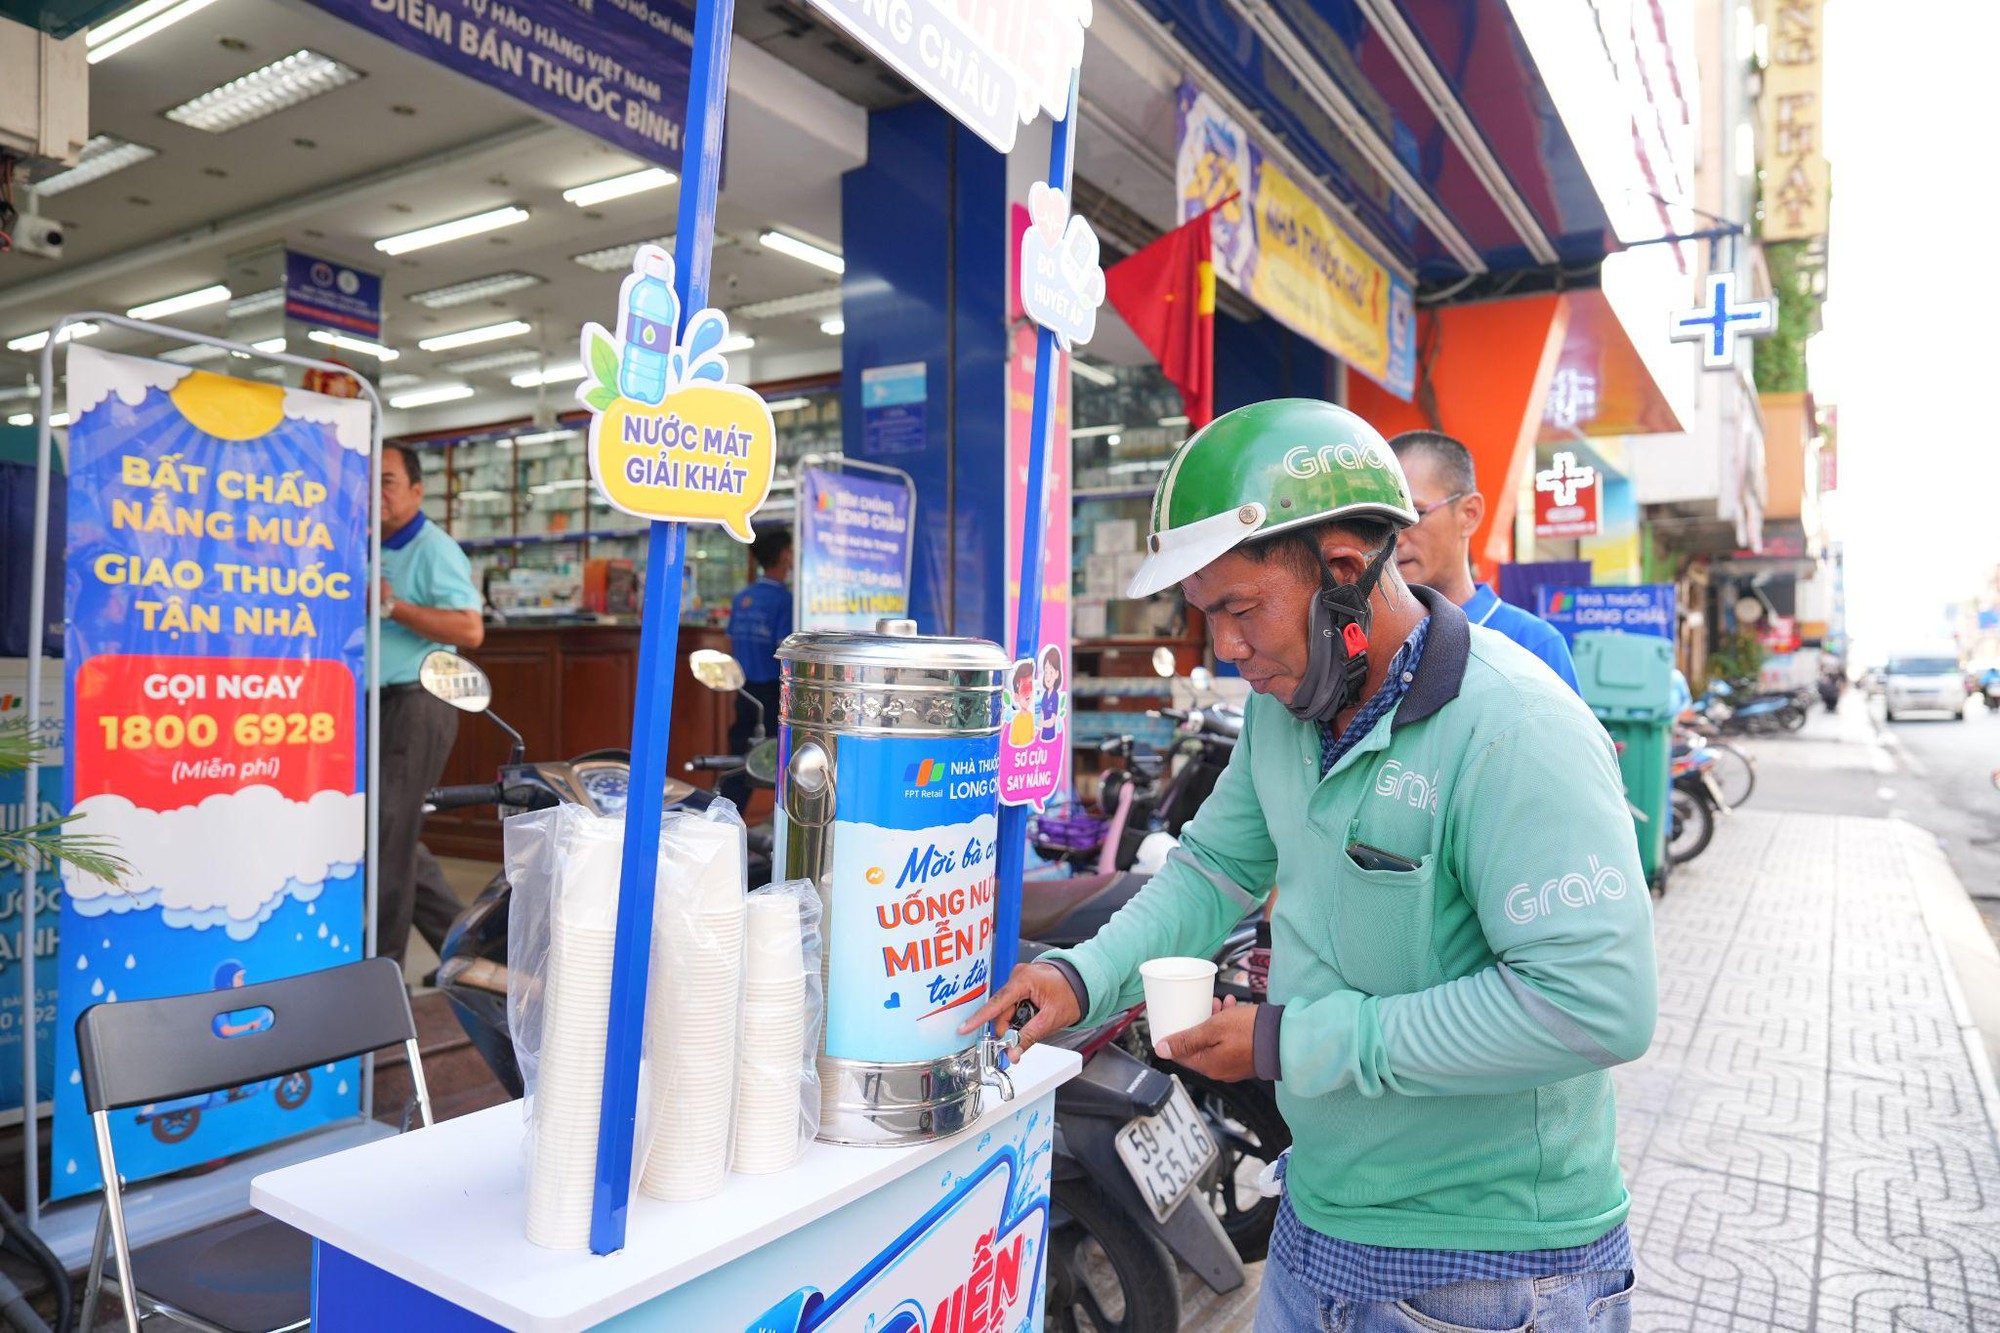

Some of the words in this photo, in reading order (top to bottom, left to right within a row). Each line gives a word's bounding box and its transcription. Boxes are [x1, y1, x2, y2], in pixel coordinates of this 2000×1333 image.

[459, 20, 523, 77] BÁN
[527, 51, 620, 122] THUỐC
[625, 98, 679, 151] BÌNH
[586, 49, 623, 82] VIỆT
[624, 69, 661, 103] NAM
[919, 23, 1000, 117] CHÂU
[624, 414, 697, 451] NƯỚC
[703, 424, 752, 458] MÁT
[1282, 432, 1386, 479] Grab
[121, 453, 206, 494] BẤT
[216, 470, 327, 509] CHẤP
[626, 451, 679, 488] GIẢI
[685, 460, 747, 494] KHÁT
[112, 492, 234, 541] NẮNG
[247, 514, 335, 551] MƯA
[94, 554, 204, 591] GIAO
[214, 561, 351, 600] THUỐC
[135, 596, 221, 640] TẬN
[234, 603, 317, 638] NHÀ
[1575, 608, 1623, 624] LONG
[144, 674, 206, 706] GỌI
[217, 674, 304, 700] NGAY
[99, 714, 218, 751] 1800
[233, 713, 335, 747] 6928
[171, 759, 236, 785] (Miễn
[240, 757, 281, 783] phí)
[950, 758, 976, 775] NHÀ
[1006, 774, 1026, 792] SAY
[904, 789, 919, 798] FPT
[921, 789, 943, 798] Retail
[949, 779, 988, 800] LONG
[895, 843, 956, 889] Mời
[961, 836, 983, 869] bà
[876, 888, 965, 930] UỐNG
[1504, 854, 1627, 925] Grab
[882, 919, 974, 978] MIỄN
[926, 974, 960, 1006] tại
